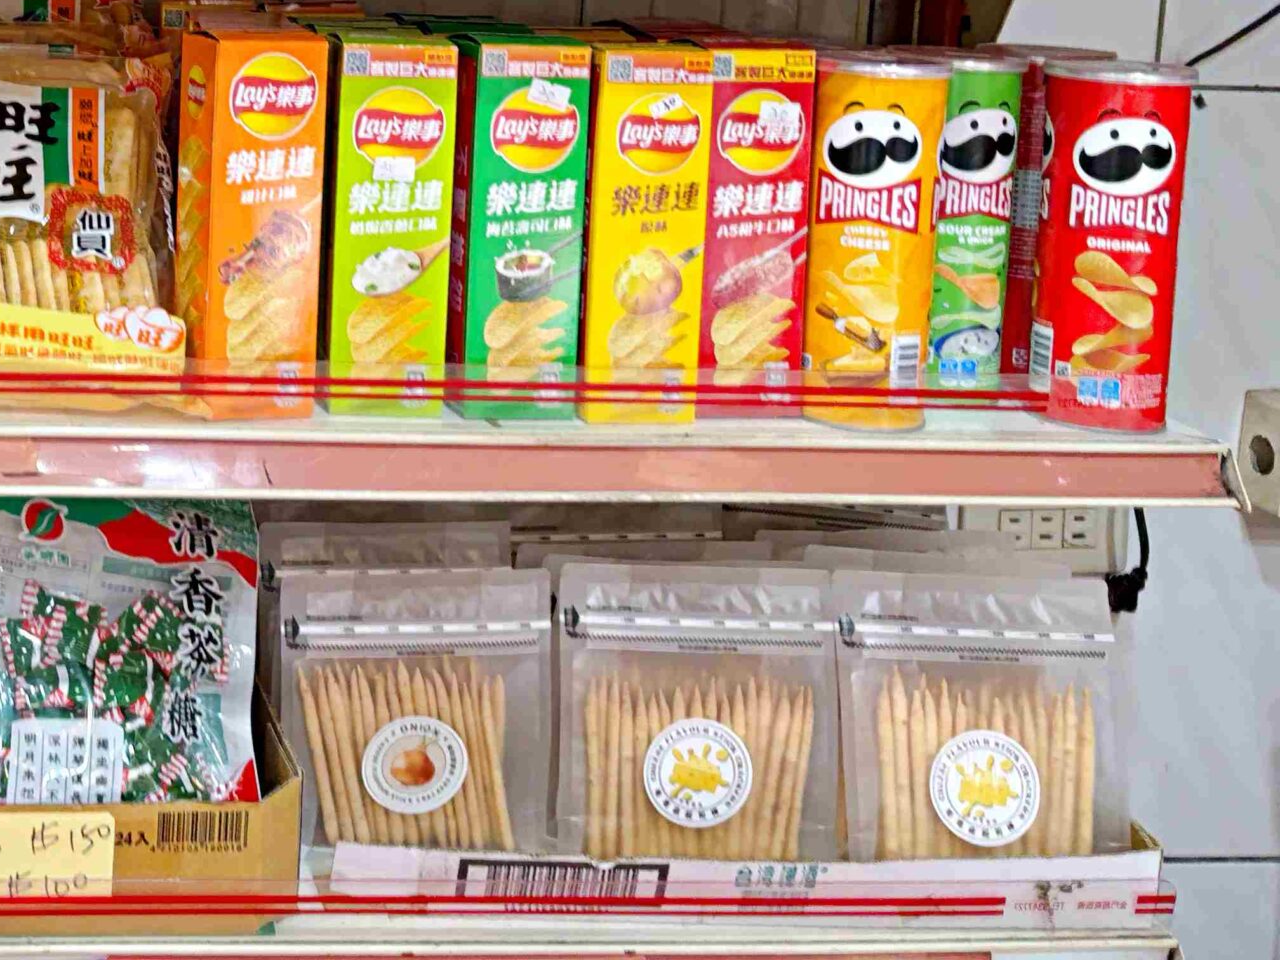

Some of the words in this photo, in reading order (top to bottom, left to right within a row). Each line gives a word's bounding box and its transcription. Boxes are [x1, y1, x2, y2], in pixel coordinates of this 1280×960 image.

[234, 81, 276, 111] Lay's
[358, 114, 401, 144] Lay's
[495, 114, 538, 144] Lay's
[621, 119, 663, 149] Lay's
[722, 117, 764, 147] Lay's
[225, 145, 317, 185] 樂連連
[347, 179, 444, 216] 樂連連
[485, 178, 577, 218] 樂連連
[611, 180, 701, 218] 樂連連
[713, 178, 804, 218] 樂連連
[819, 178, 918, 230] PRINGLES
[937, 174, 1012, 218] PRINGLES
[1068, 183, 1171, 236] PRINGLES
[71, 208, 115, 259] 仙貝
[839, 235, 891, 251] CHEESE
[937, 222, 973, 237] SOUR
[1086, 235, 1152, 254] ORIGINAL
[164, 511, 225, 742] 清香茶糖
